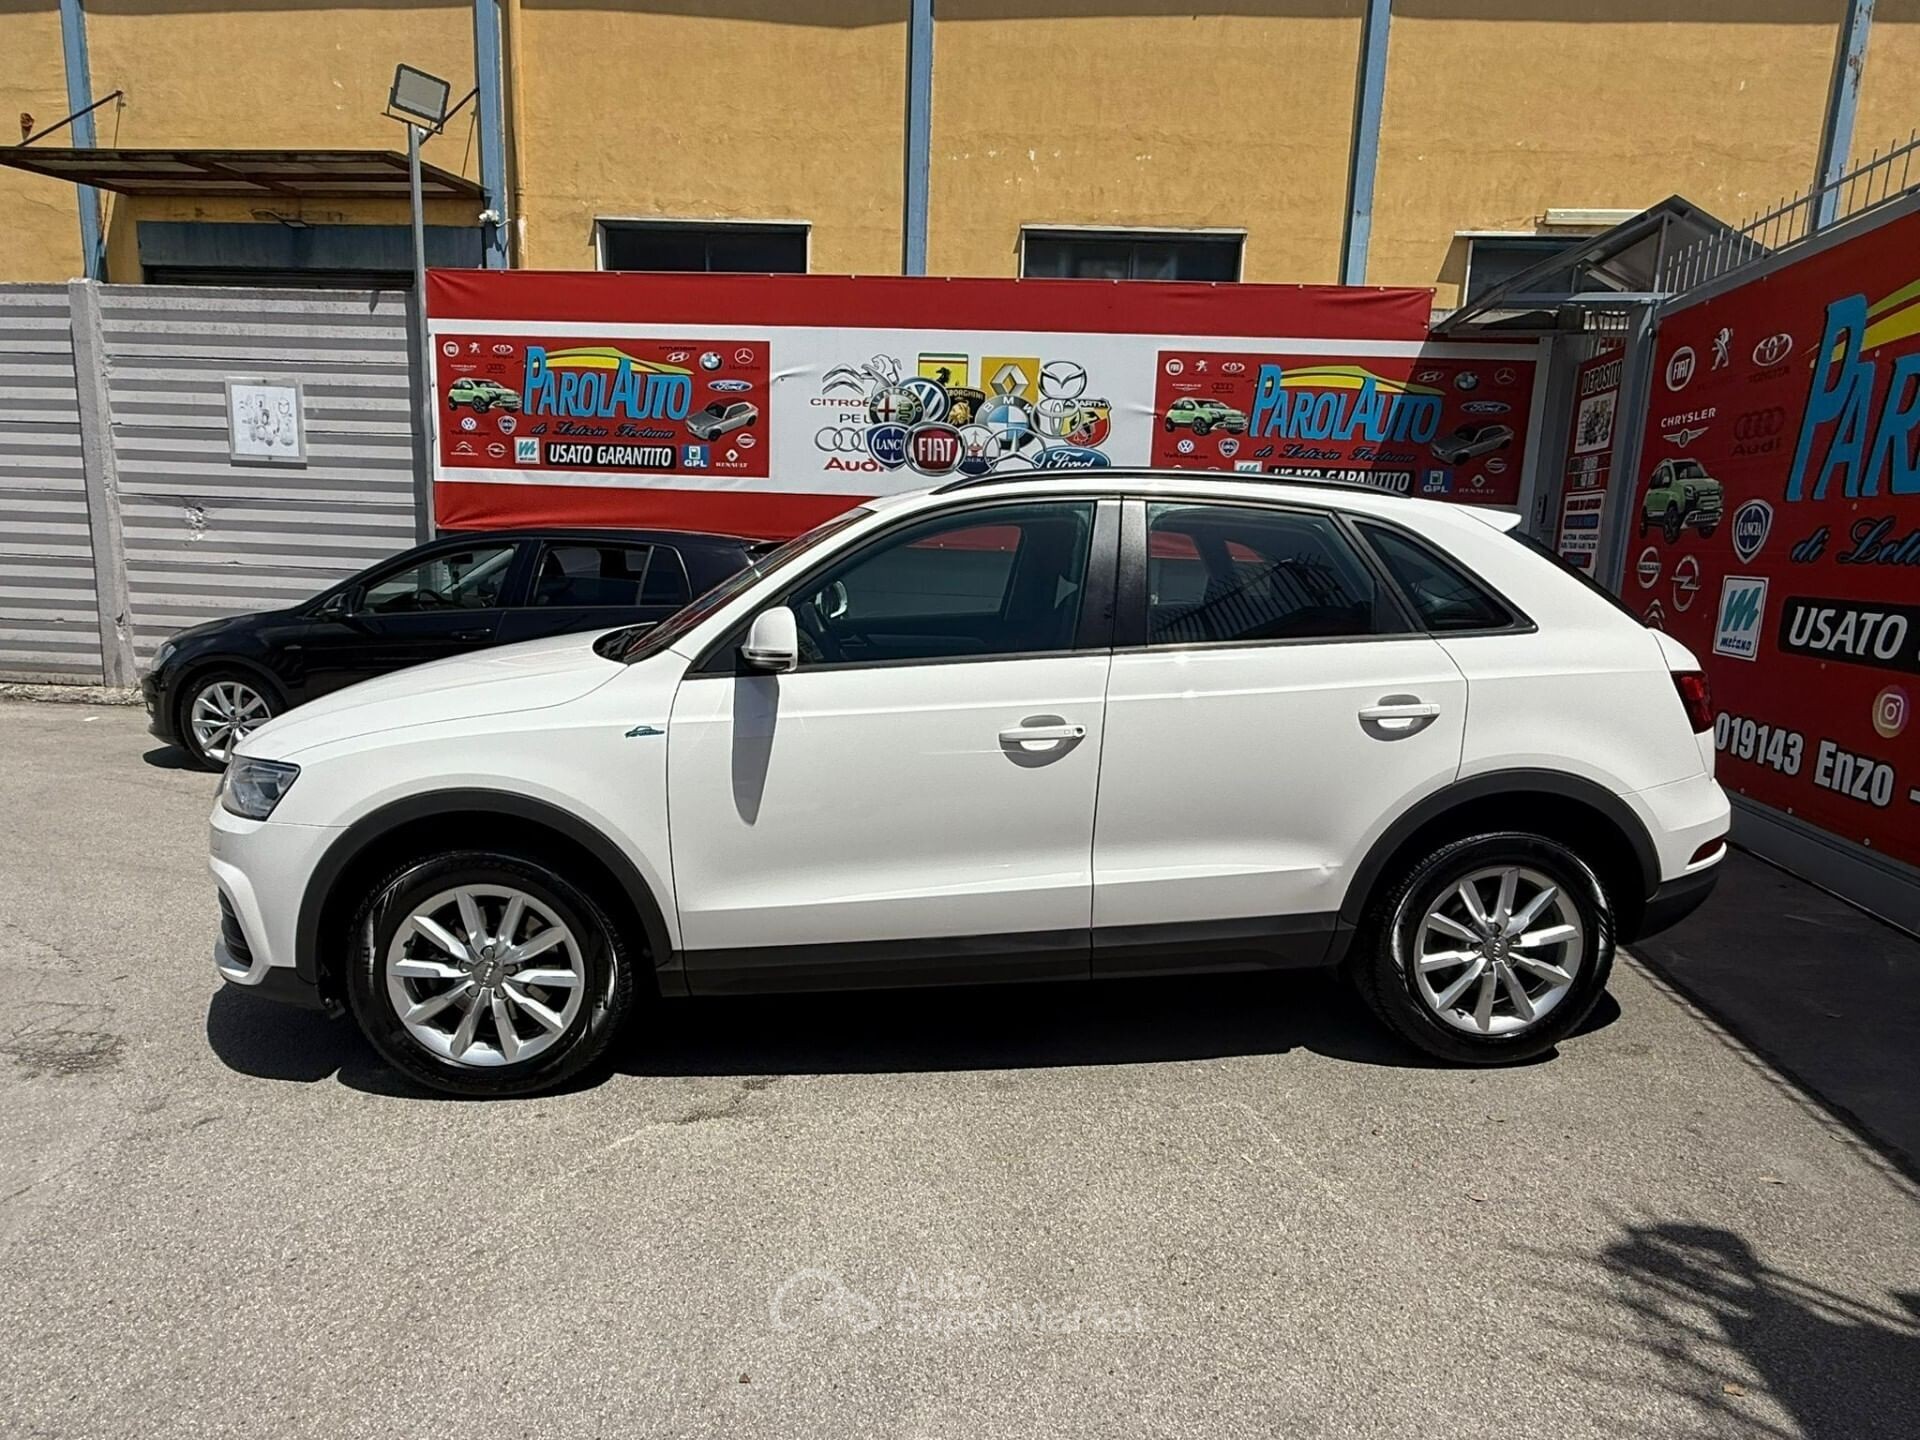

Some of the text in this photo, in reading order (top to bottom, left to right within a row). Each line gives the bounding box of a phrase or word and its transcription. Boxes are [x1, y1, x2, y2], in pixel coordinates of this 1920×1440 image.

[1582, 359, 1624, 395] DEPOSITO
[1672, 358, 1691, 381] FIAT
[1065, 400, 1106, 408] AARTH
[1660, 407, 1717, 428] CHRYSLER
[549, 444, 672, 467] USATO GARANTITO
[918, 437, 954, 462] FIAT
[684, 459, 708, 468] GPL
[1423, 485, 1448, 493] GPL
[1738, 522, 1763, 536] LANCIA
[1788, 605, 1908, 660] USATO
[1715, 712, 1804, 775] 019143
